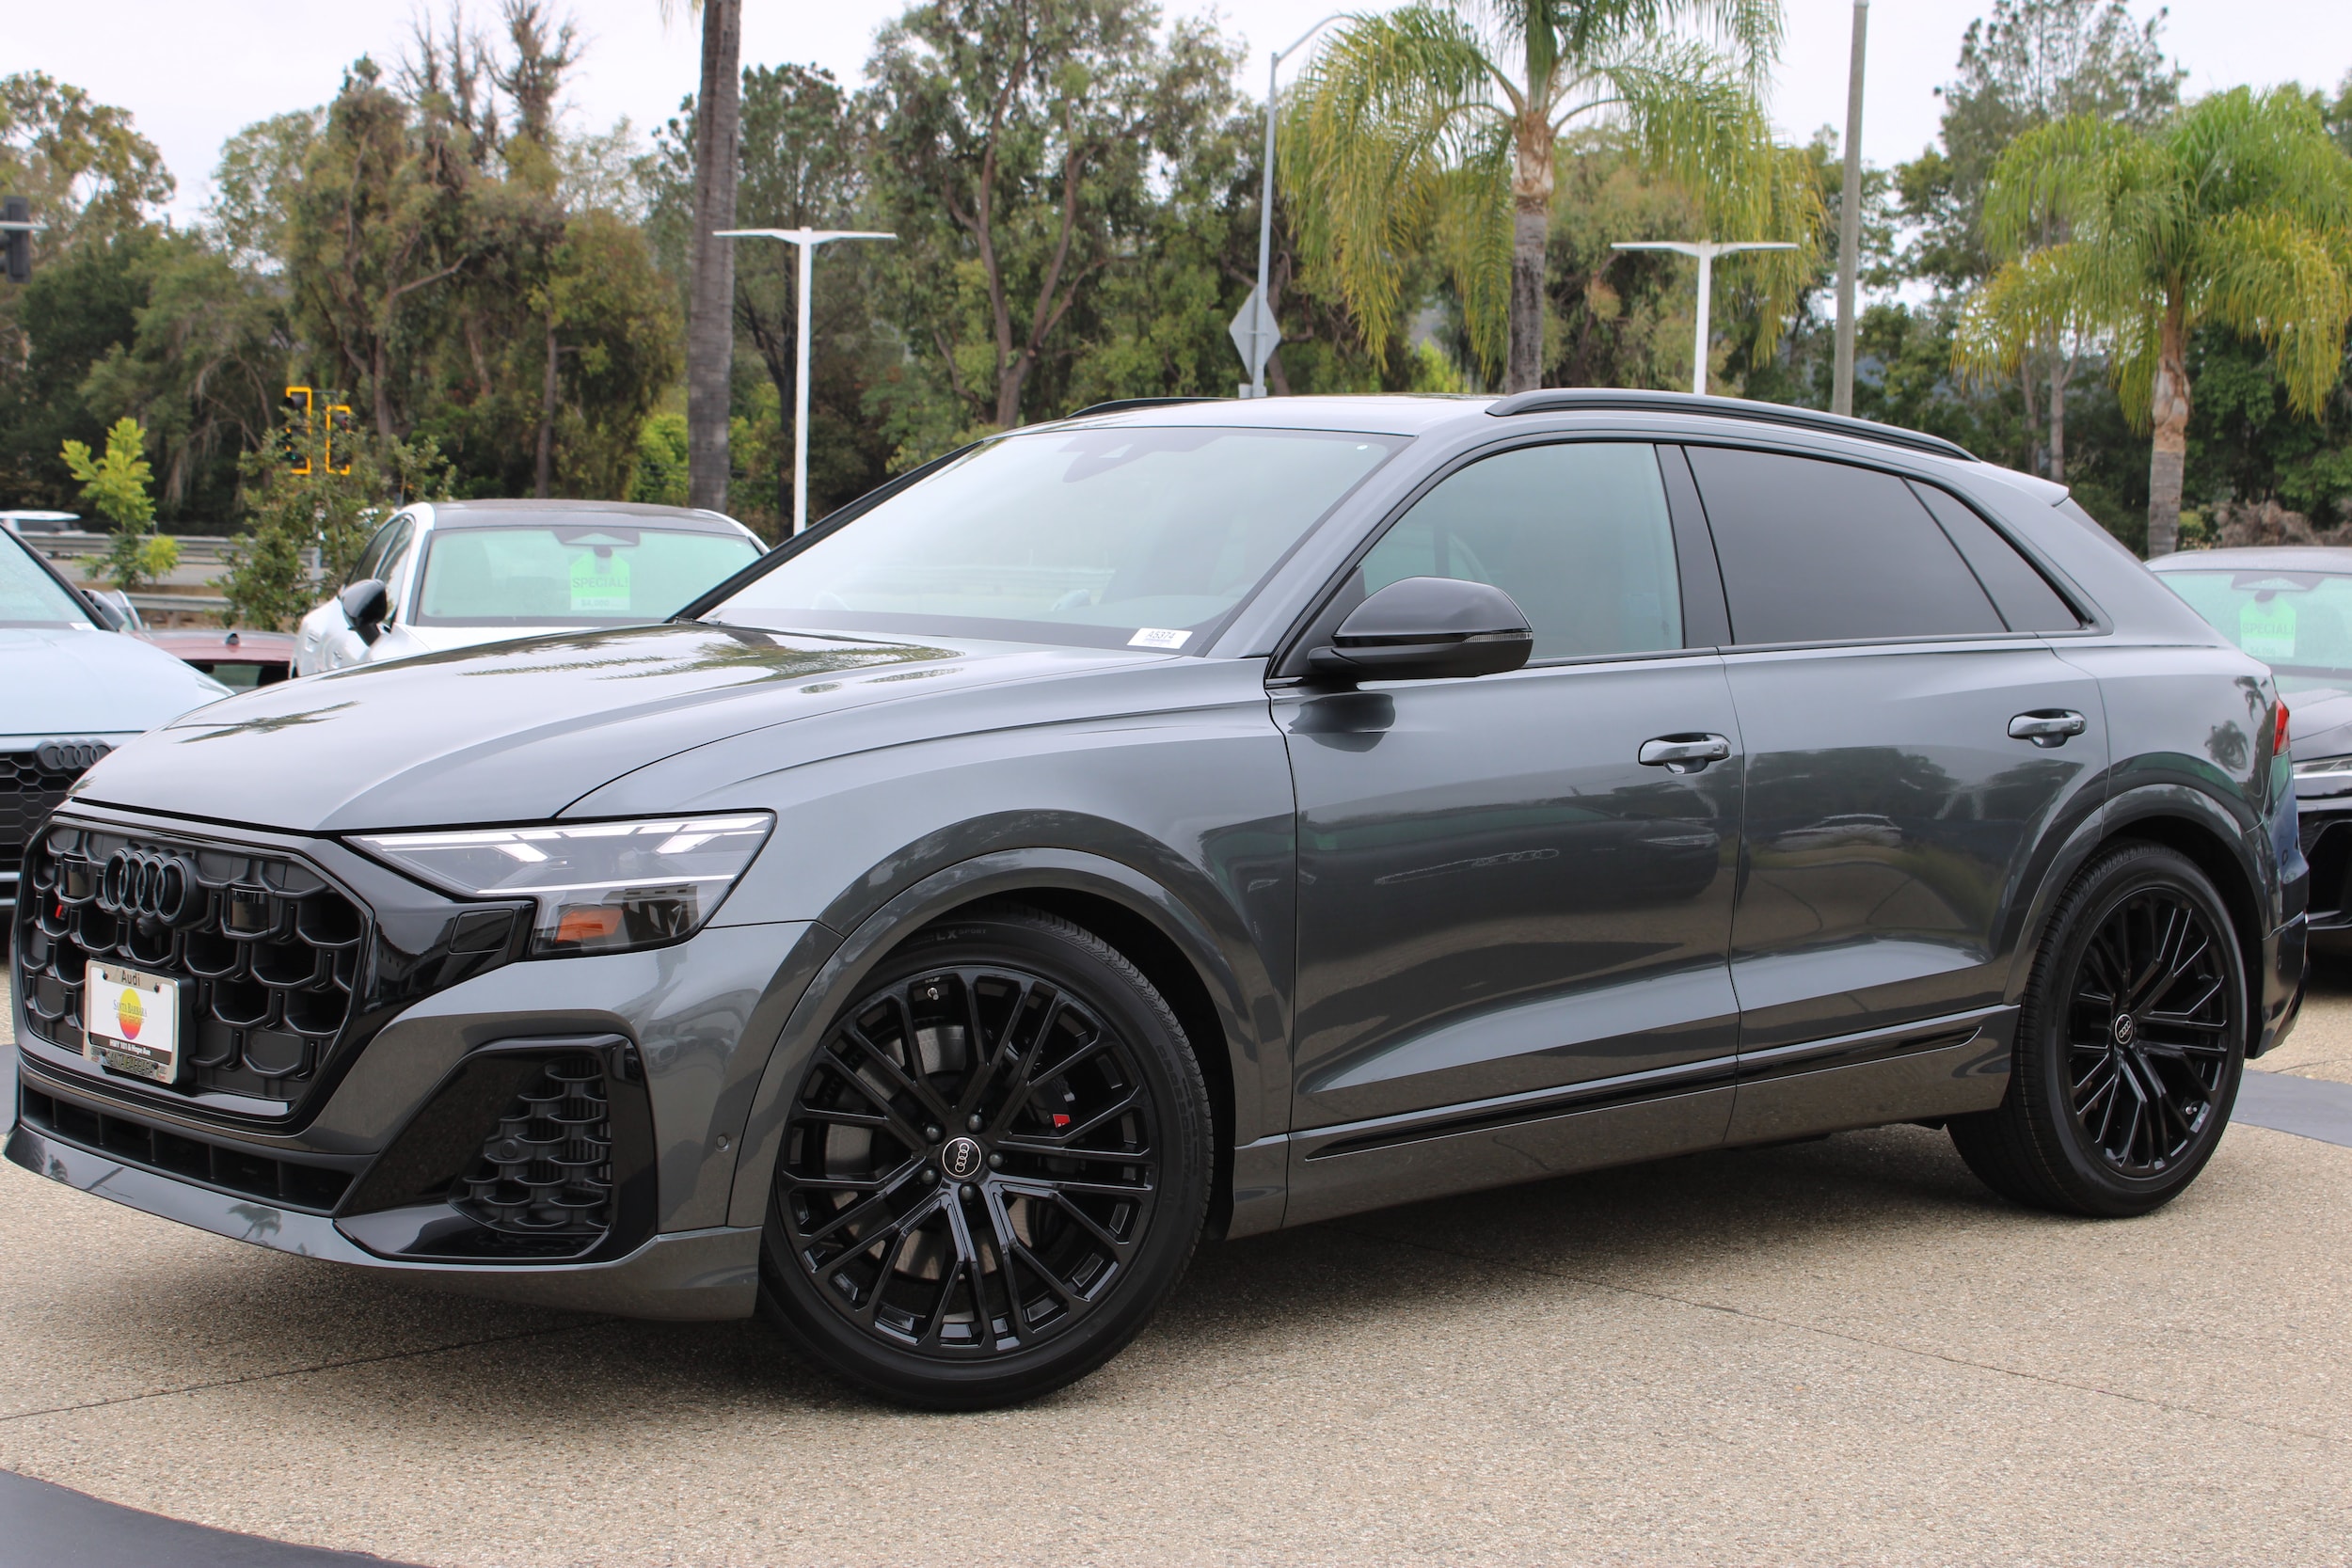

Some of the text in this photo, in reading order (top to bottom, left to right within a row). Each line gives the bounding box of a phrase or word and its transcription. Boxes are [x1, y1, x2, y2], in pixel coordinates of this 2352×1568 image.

[572, 577, 628, 588] SPECIAL!
[936, 928, 958, 942] LX
[958, 927, 987, 935] SPORT
[120, 970, 141, 987] Audi
[113, 998, 128, 1012] SANTA
